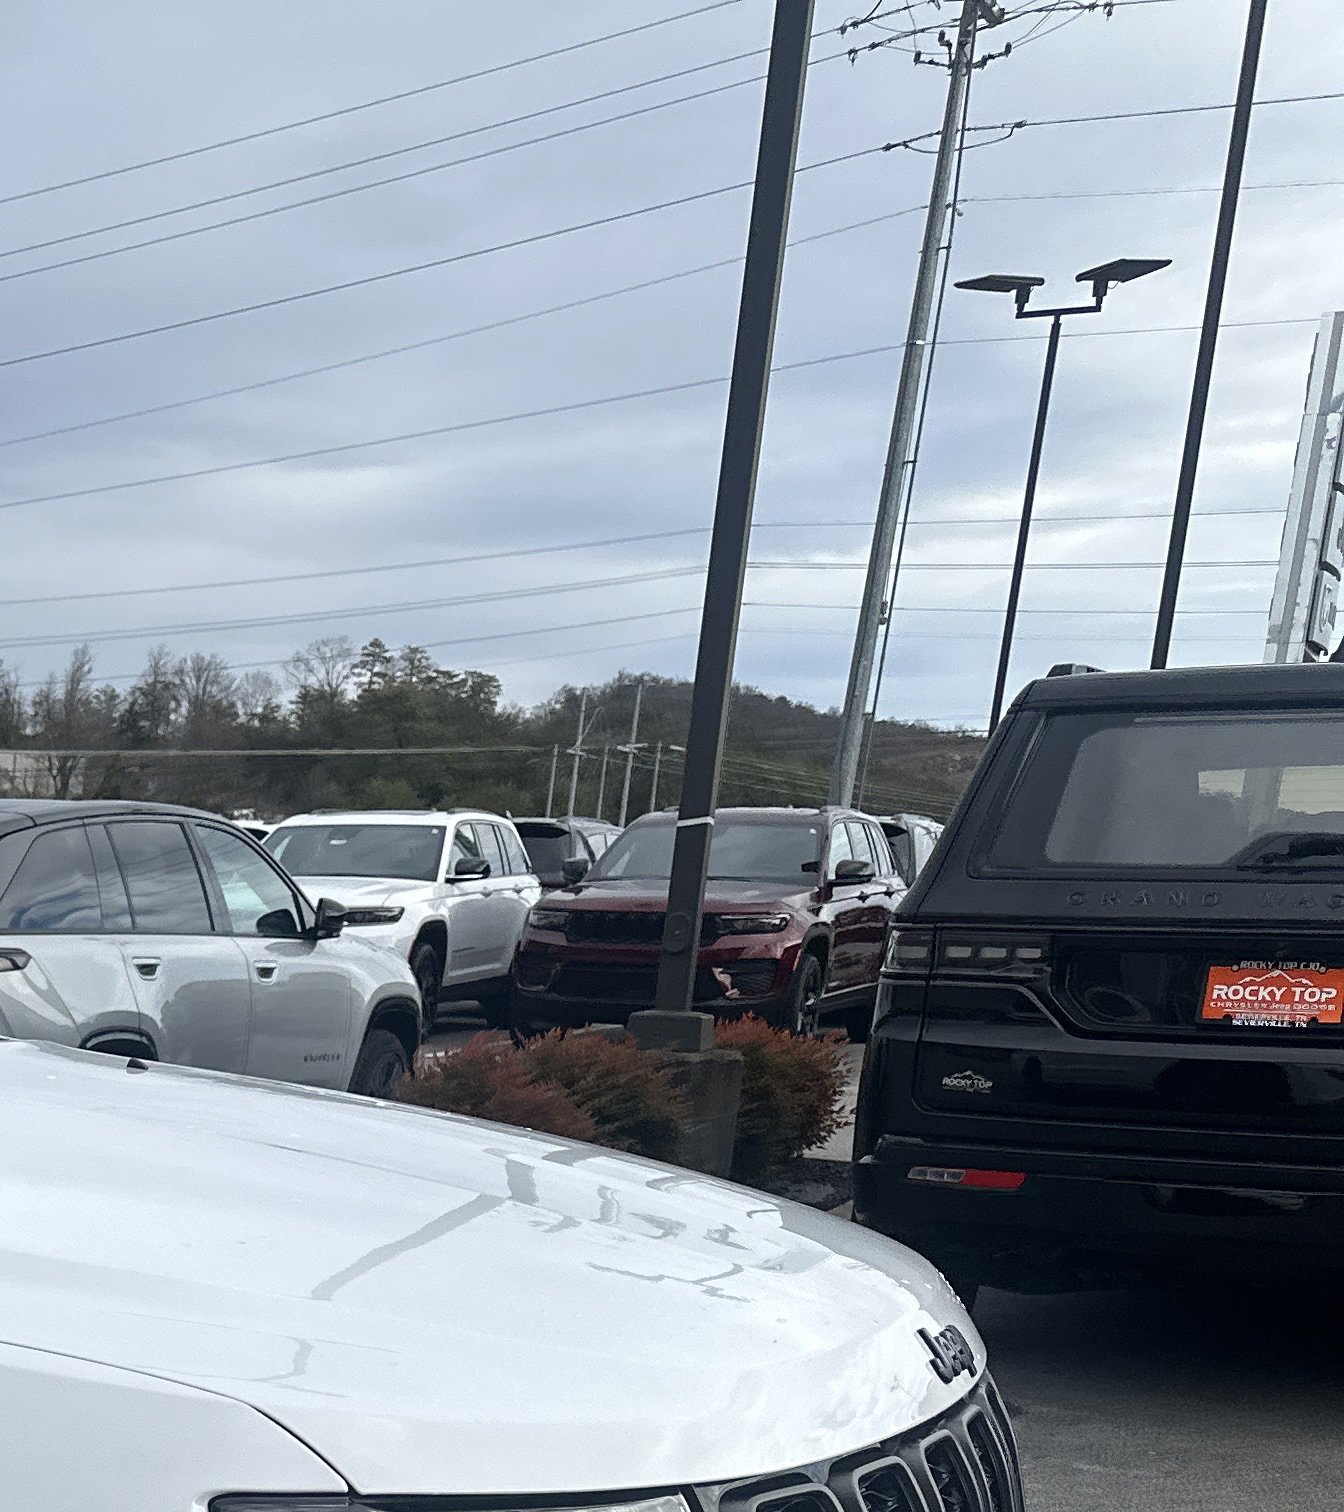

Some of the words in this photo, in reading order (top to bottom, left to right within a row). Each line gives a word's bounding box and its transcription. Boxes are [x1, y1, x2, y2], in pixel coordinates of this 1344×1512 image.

[1066, 889, 1225, 908] GRAND
[1212, 985, 1287, 1001] ROCKY
[1291, 987, 1338, 1003] TOP
